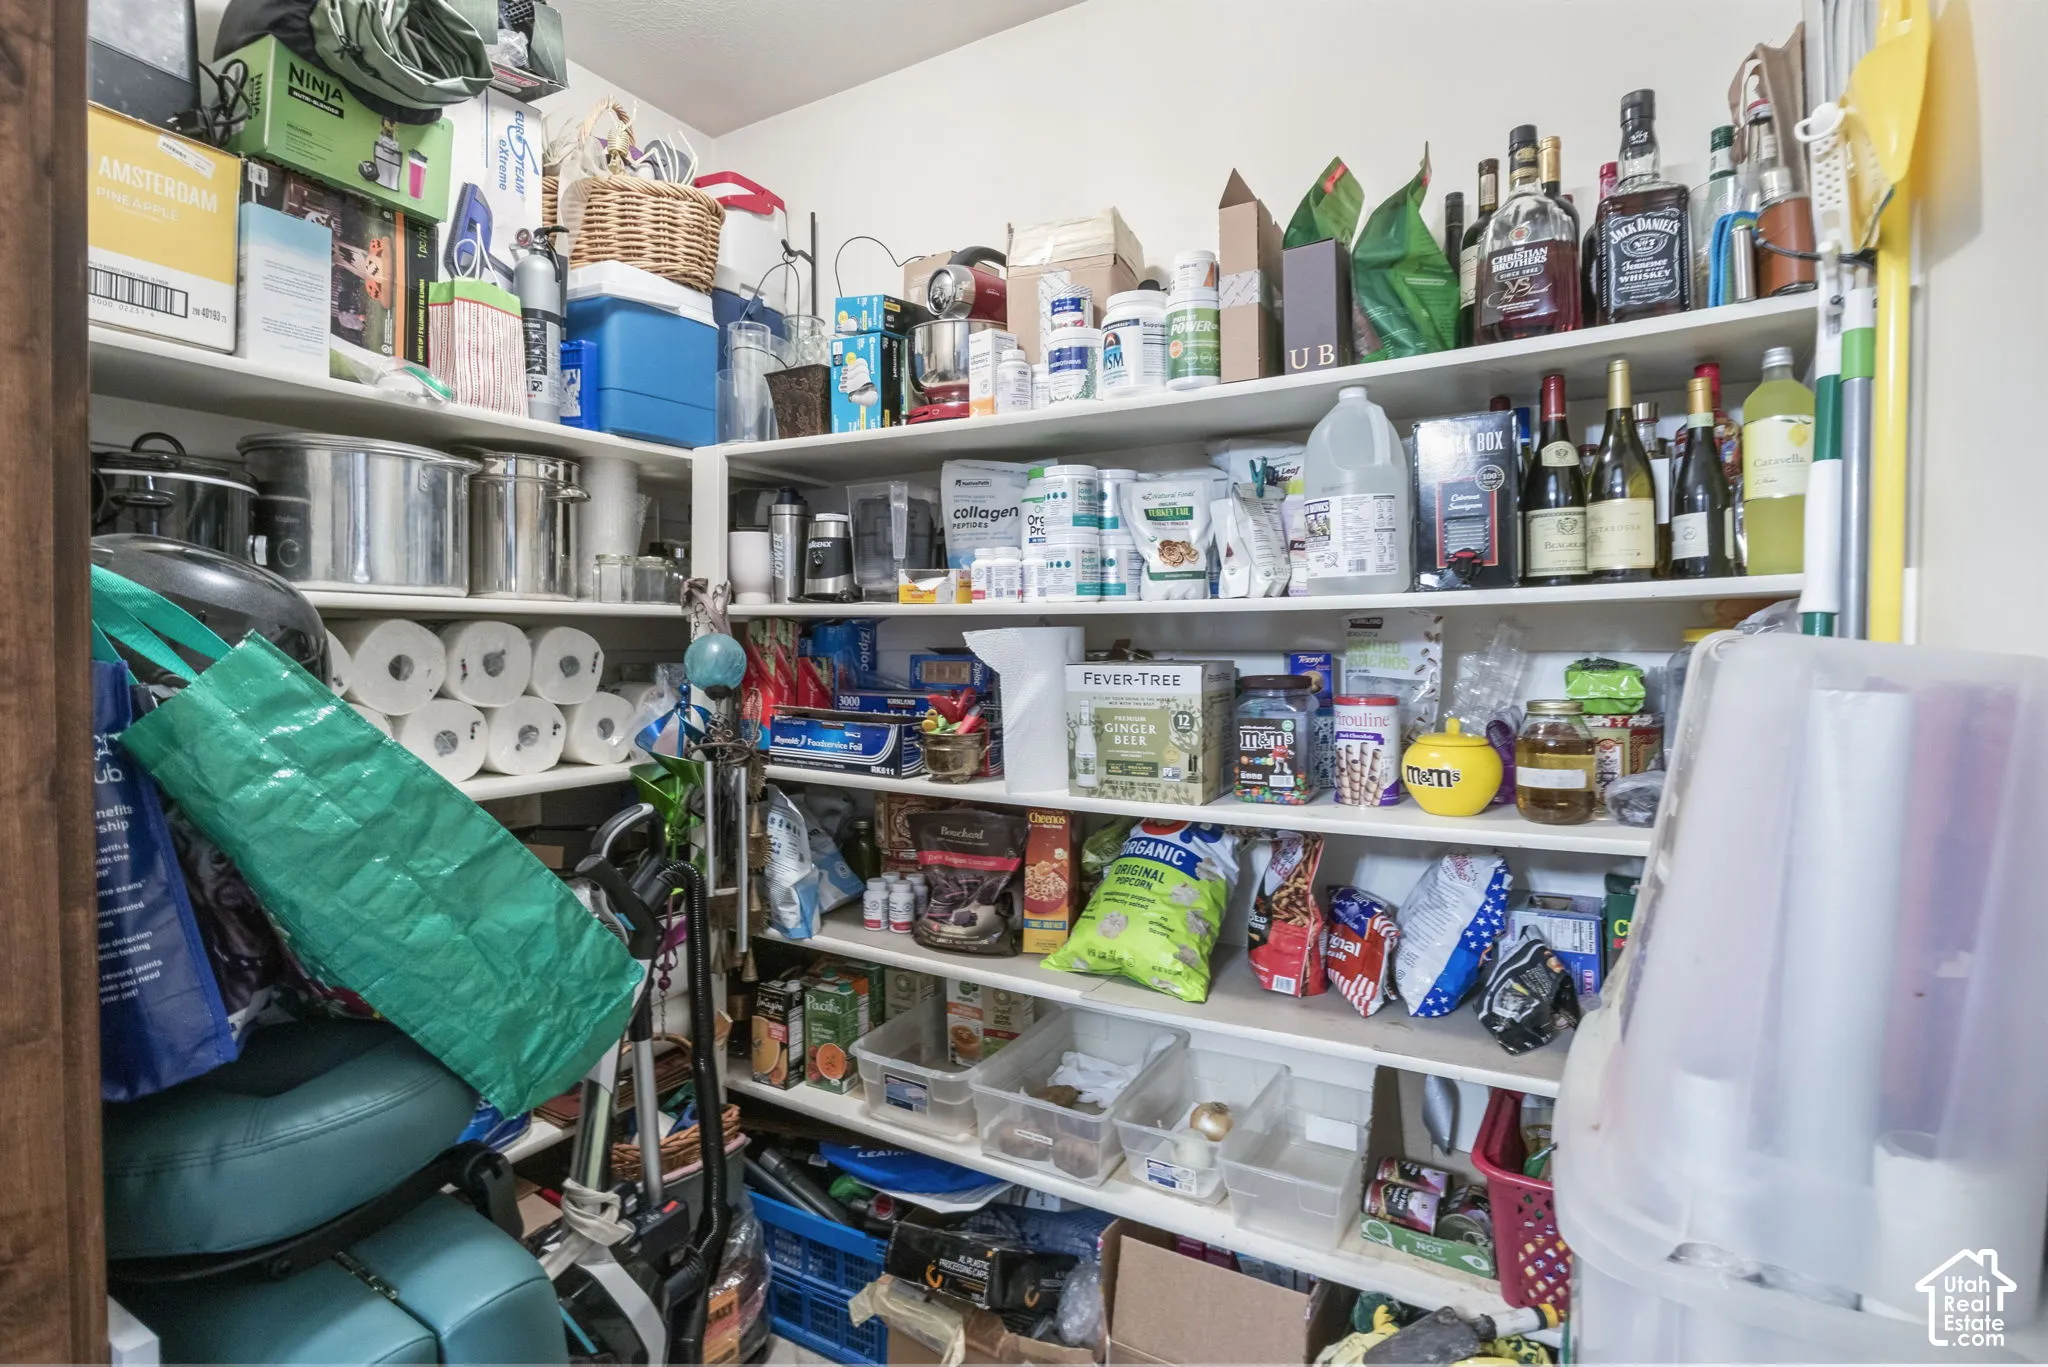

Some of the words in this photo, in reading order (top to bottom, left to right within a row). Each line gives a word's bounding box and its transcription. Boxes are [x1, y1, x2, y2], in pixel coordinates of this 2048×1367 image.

[288, 62, 344, 103] NINJA
[498, 138, 509, 191] eXtreme
[98, 155, 218, 214] AMSTERDAM
[96, 186, 180, 221] PINEAPPLE
[1609, 222, 1637, 245] JACK
[1637, 217, 1681, 235] DANIEL'S
[1491, 246, 1549, 266] CHRISTIAN
[1492, 255, 1548, 274] BROTHERS
[1621, 258, 1669, 272] Tennessee
[1619, 268, 1672, 283] WHISKEY
[1170, 320, 1212, 336] POWER
[1290, 348, 1310, 370] U
[1318, 343, 1335, 366] B
[1477, 430, 1504, 452] BOX
[1753, 453, 1806, 468] Caravella
[1281, 466, 1301, 475] Leaf
[1152, 492, 1177, 500] Natural
[1451, 493, 1480, 502] Cabernet
[953, 505, 1019, 522] collagen
[1148, 509, 1174, 517] TURKEY
[1176, 507, 1191, 516] TAIL
[1448, 503, 1483, 511] Sauvignon
[952, 522, 989, 530] PEPTIDES
[858, 630, 871, 672] Ziploc
[973, 662, 982, 687] Ziploc
[1083, 671, 1181, 687] FEVER-TREE
[839, 695, 860, 707] 3000
[887, 698, 916, 706] KIRKLAND
[1177, 714, 1191, 727] 12
[1104, 723, 1157, 734] GINGER
[774, 735, 800, 746] Reynolds
[807, 738, 848, 750] Foodservice
[849, 742, 863, 751] Foil
[1114, 735, 1147, 746] BEER
[870, 765, 895, 776] RK611
[1029, 812, 1066, 825] Cheerios
[941, 825, 984, 840] Bouchard
[100, 844, 120, 854] with
[1120, 840, 1187, 866] ORGANIC
[113, 853, 129, 862] the
[1115, 864, 1165, 884] ORIGINAL
[1115, 876, 1154, 891] POPCORN
[112, 930, 153, 946] detection
[120, 943, 151, 957] testing
[102, 968, 133, 981] reward
[135, 959, 163, 974] points
[120, 980, 137, 990] you
[139, 970, 160, 983] need
[101, 993, 119, 1005] your
[757, 995, 784, 1014] Imagine
[805, 994, 842, 1015] Pacific
[1416, 1241, 1443, 1255] NOT
